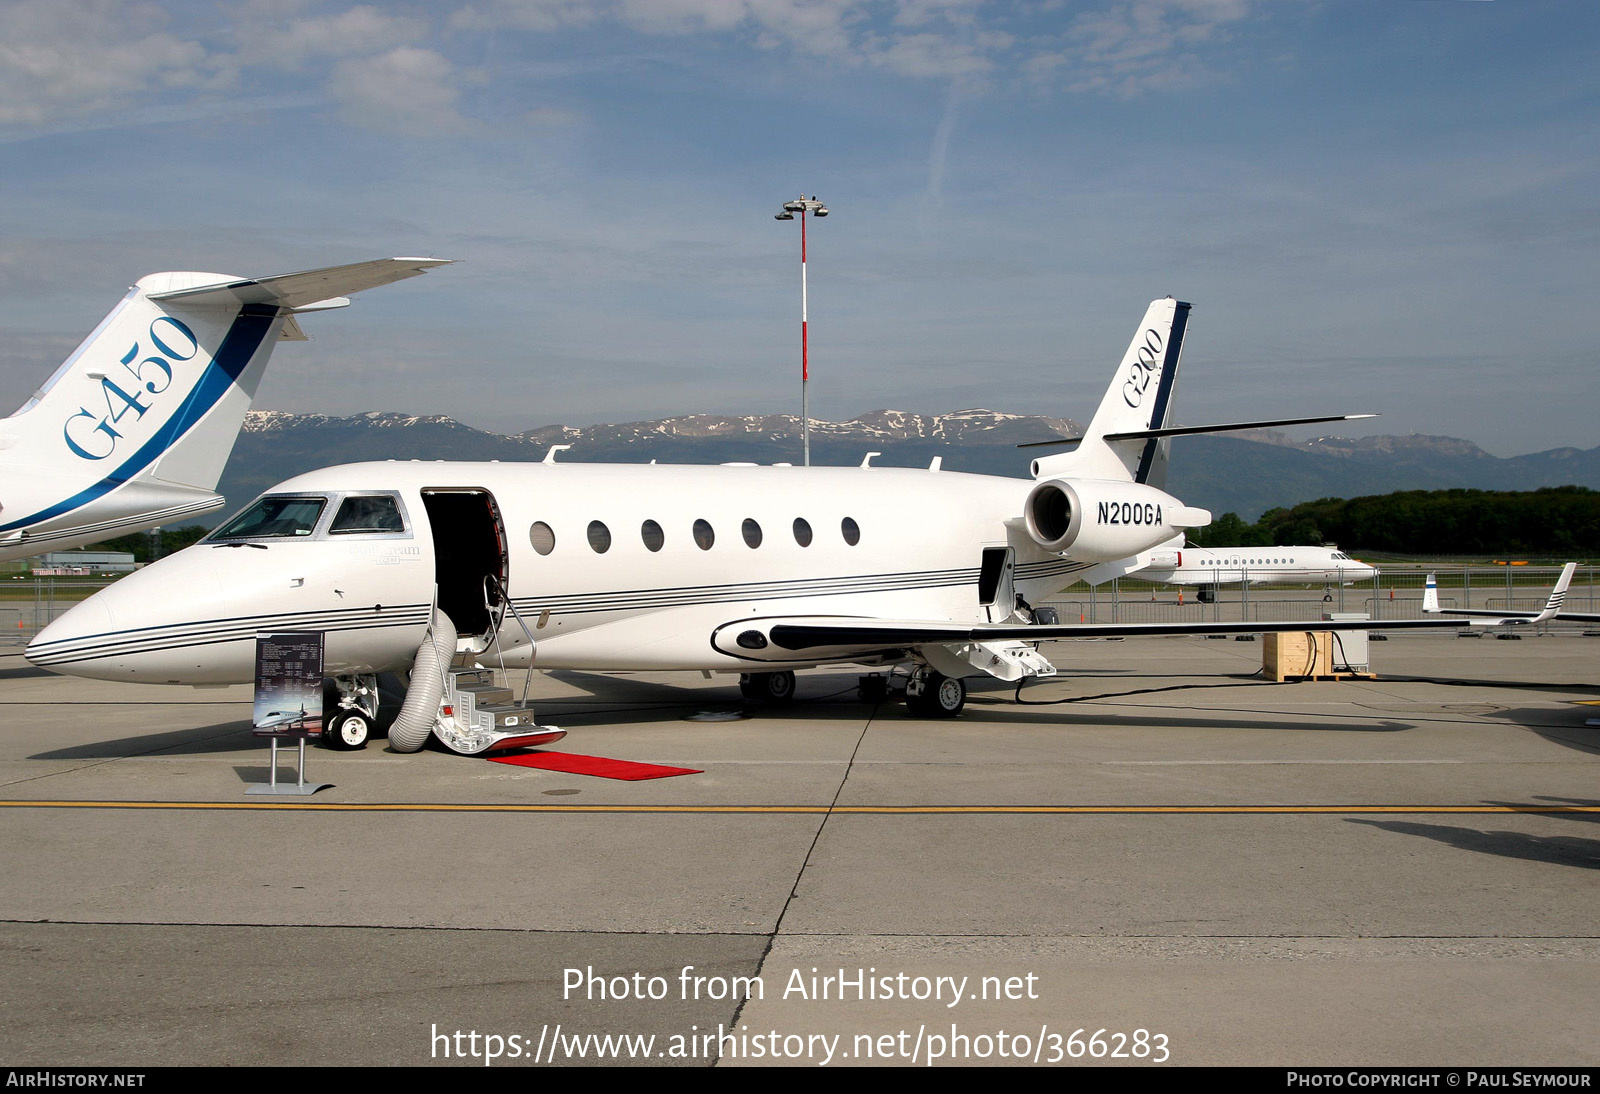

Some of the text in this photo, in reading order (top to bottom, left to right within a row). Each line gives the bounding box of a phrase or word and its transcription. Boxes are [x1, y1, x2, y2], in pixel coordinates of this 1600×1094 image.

[64, 316, 198, 460] G450
[1122, 328, 1163, 408] G200
[1097, 501, 1162, 525] N200GA
